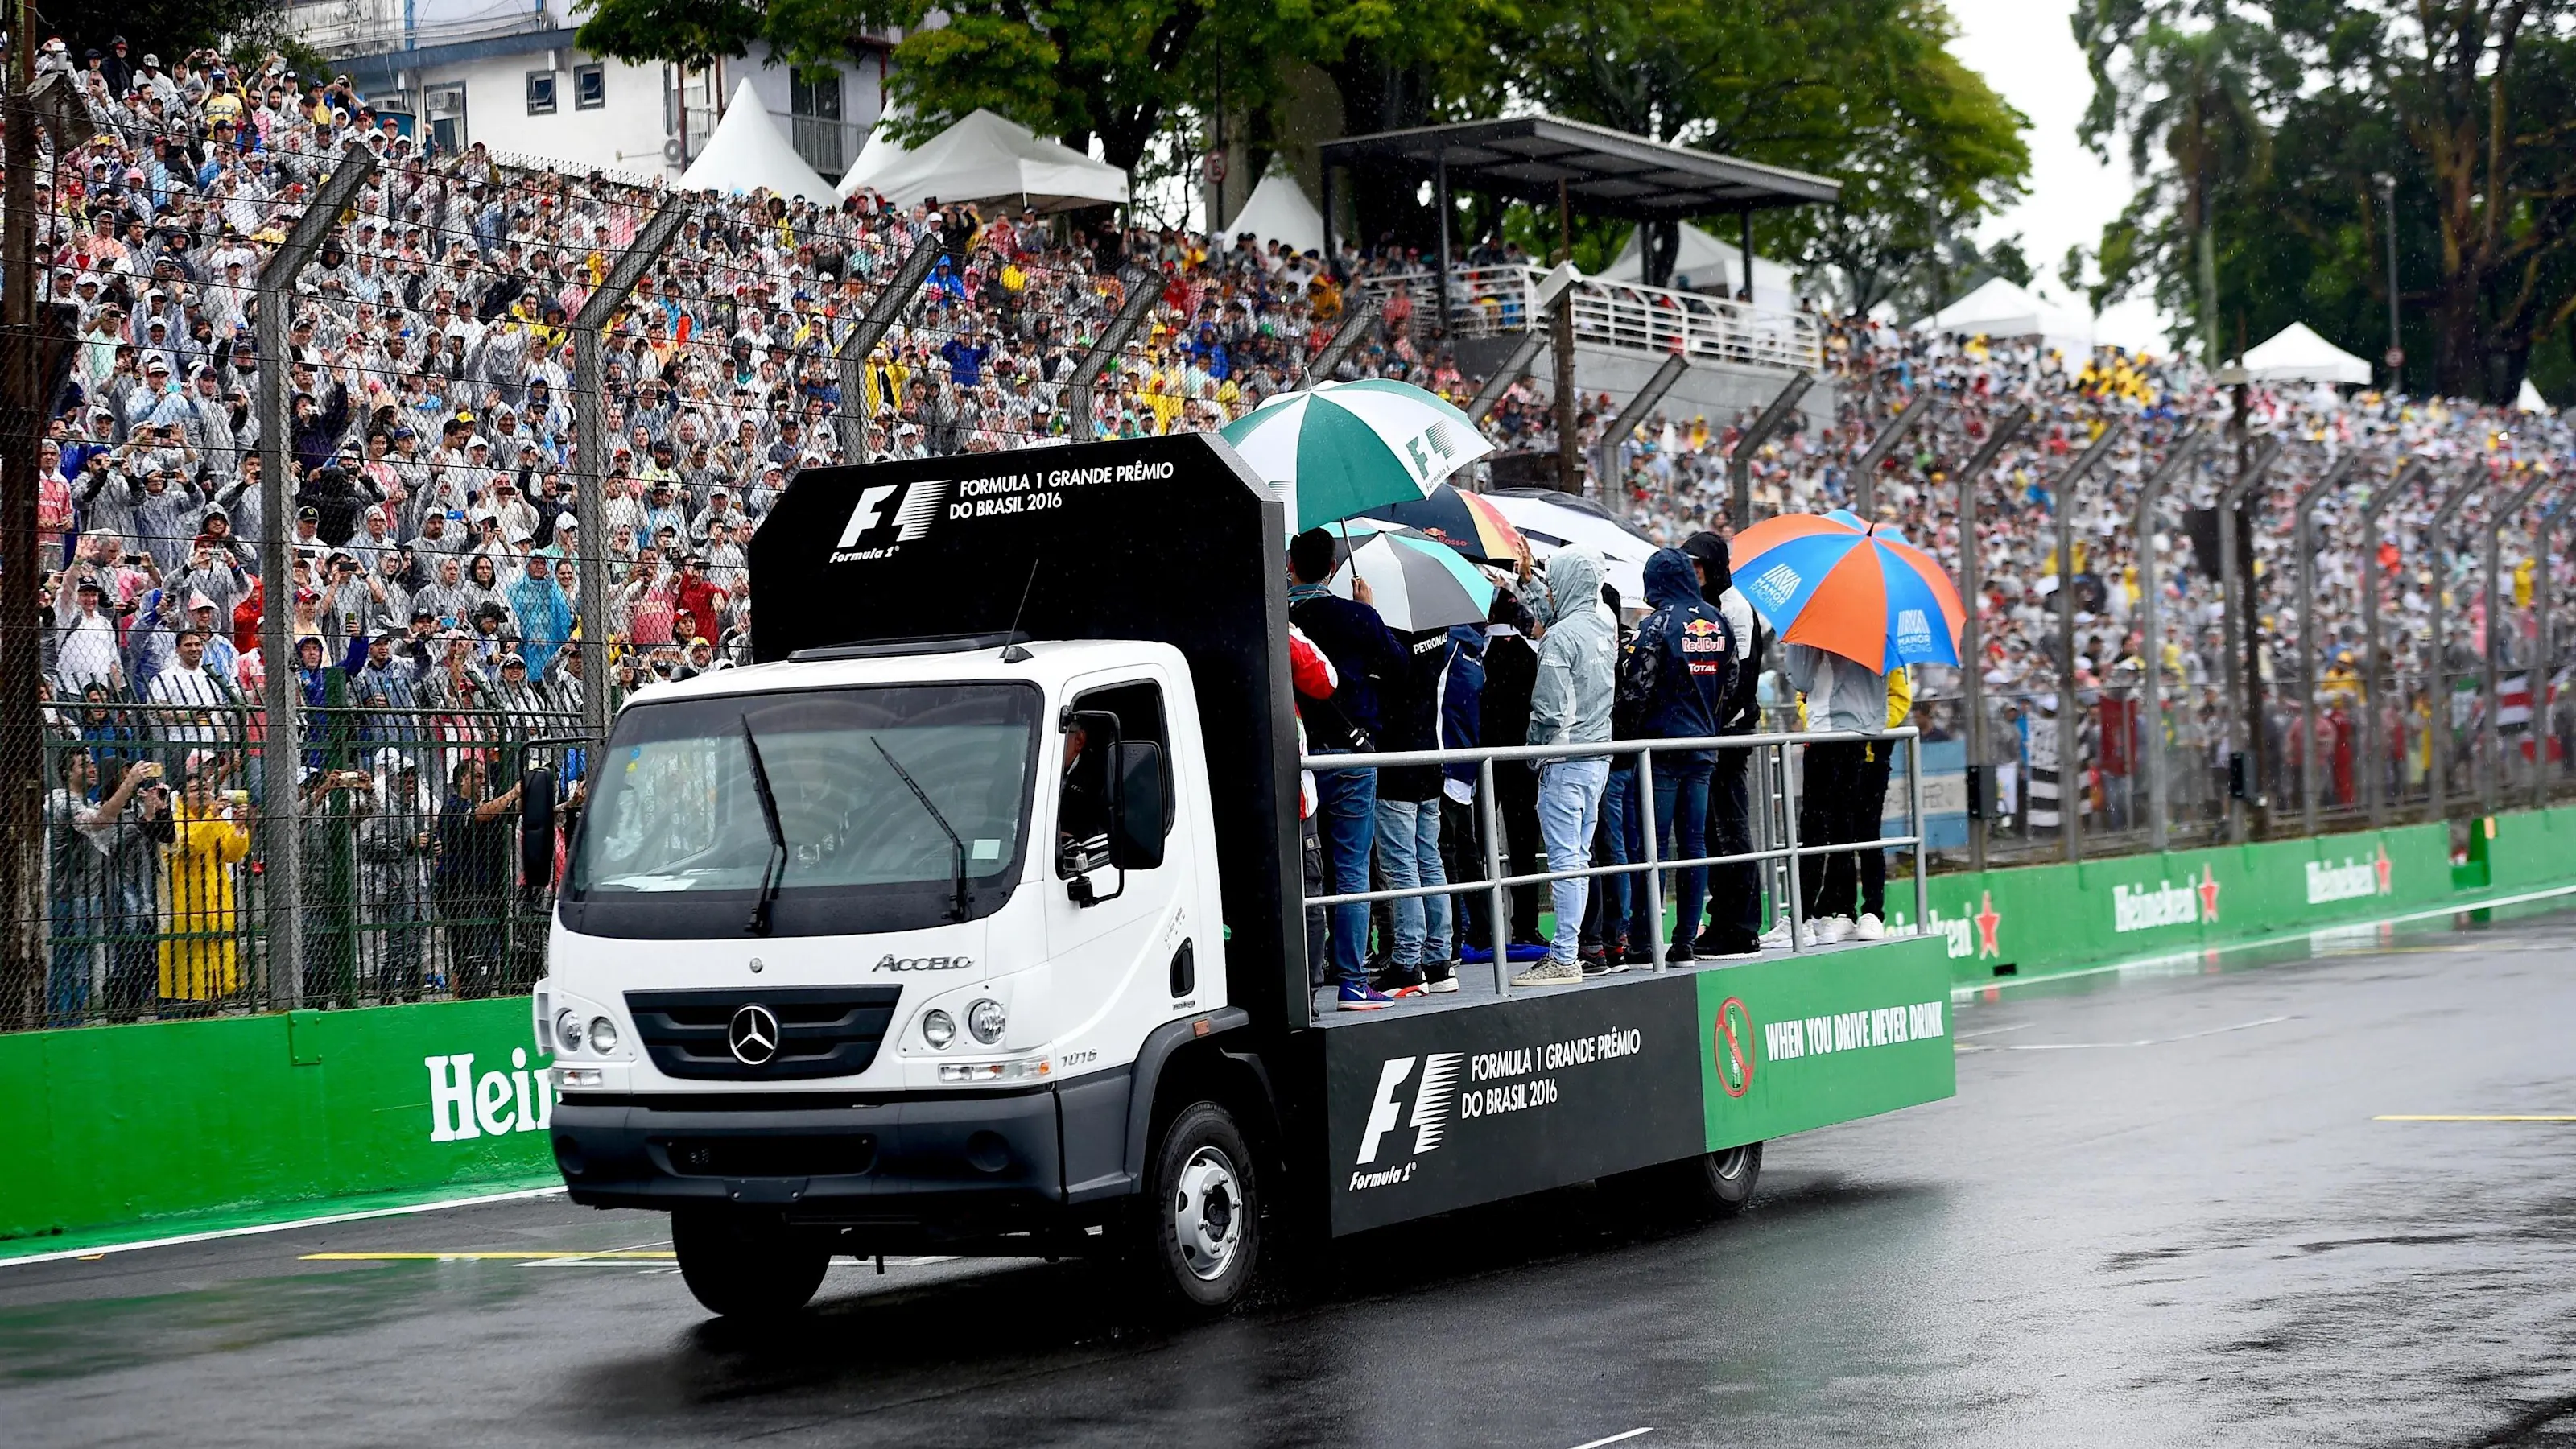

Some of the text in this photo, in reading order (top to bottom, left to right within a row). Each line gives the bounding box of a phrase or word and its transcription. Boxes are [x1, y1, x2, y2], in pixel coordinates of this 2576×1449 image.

[960, 460, 1174, 497] FORMULA 1 GRANDE PRÊMIO
[949, 493, 1063, 520] DO BRASIL 2016
[829, 547, 884, 564] Formula
[1748, 584, 1780, 613] RACING
[1754, 576, 1786, 606] MANOR
[1897, 634, 1931, 646] MANOR
[1688, 663, 1717, 672] TOTAL
[1765, 1001, 1944, 1062] WHEN YOU DRIVE NEVER DRINK
[1061, 1048, 1098, 1067] 1016
[1472, 1025, 1641, 1082] FORMULA 1 GRANDE PRÊMIO
[1461, 1077, 1558, 1120] DO BRASIL 2016
[1348, 1165, 1402, 1191] Formula
